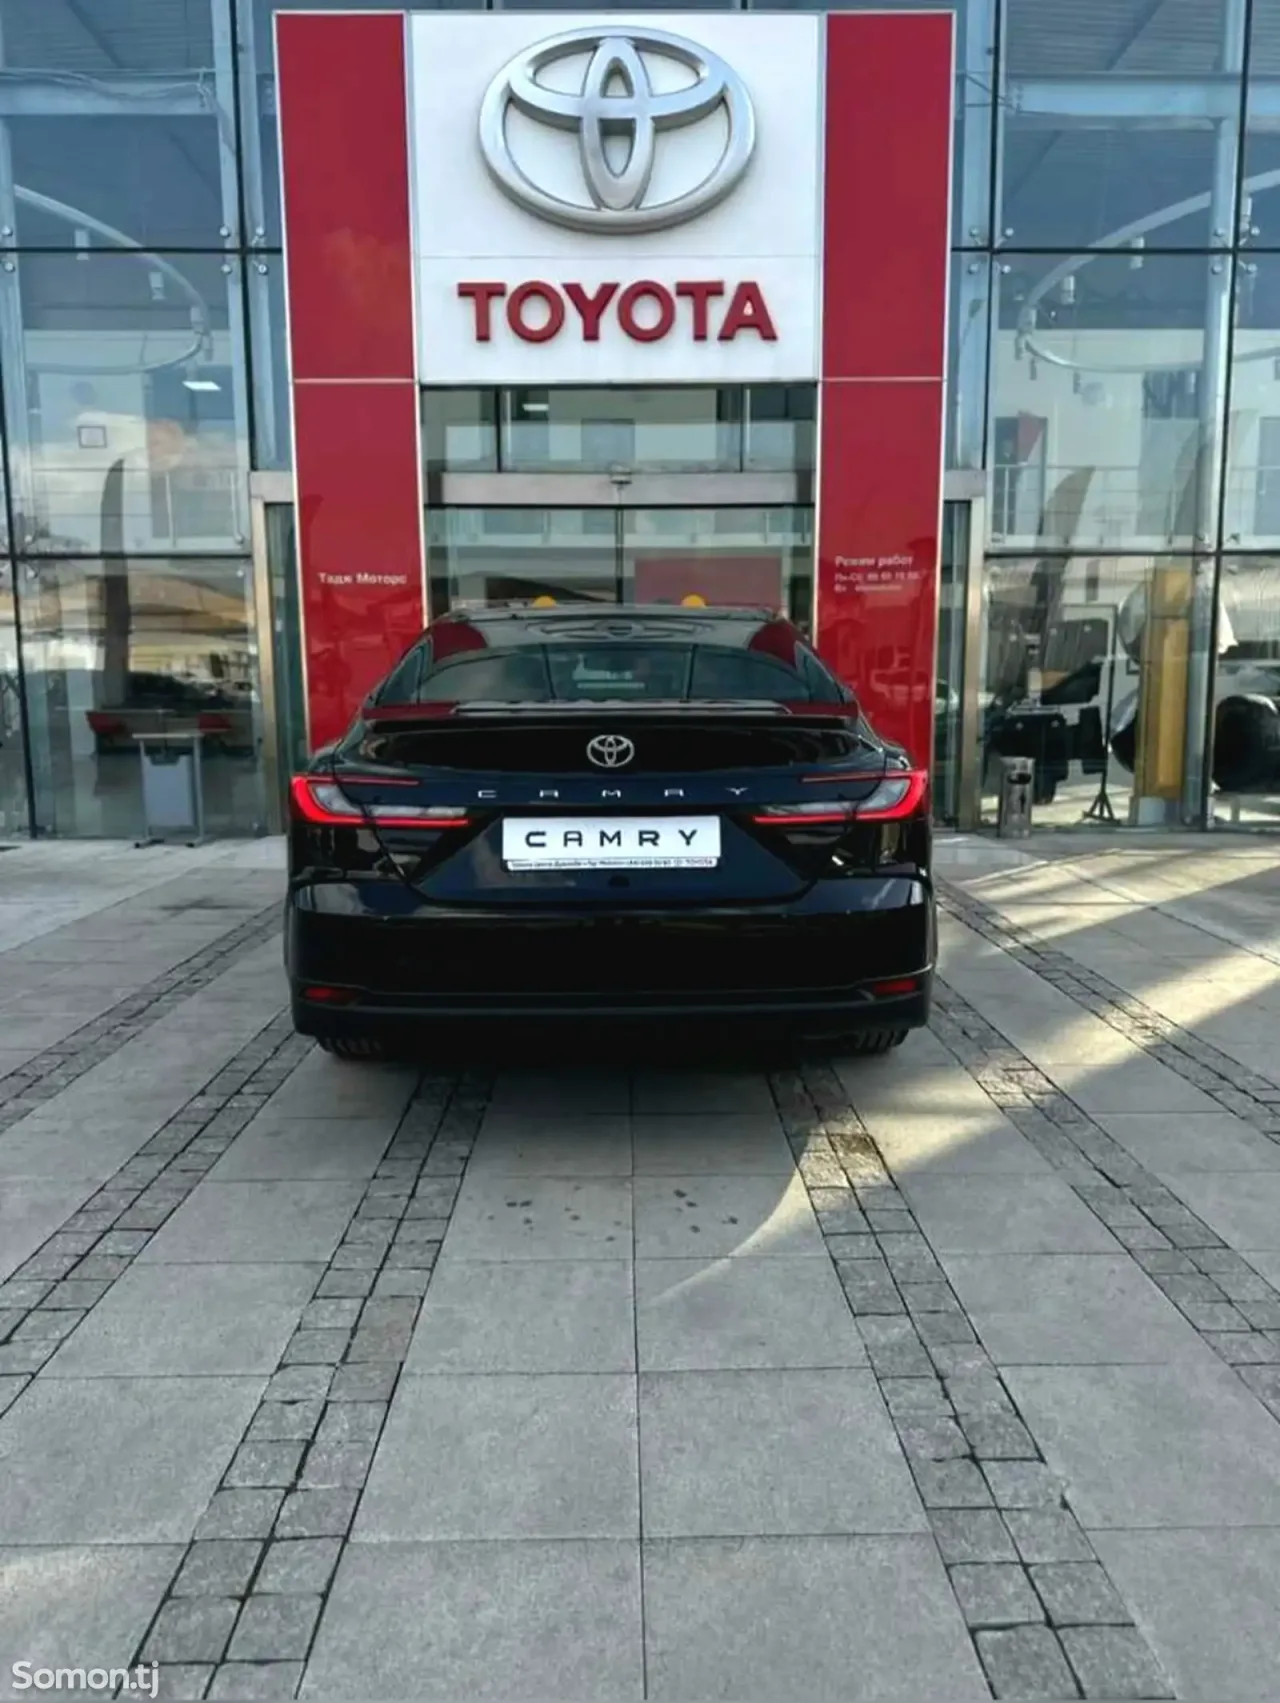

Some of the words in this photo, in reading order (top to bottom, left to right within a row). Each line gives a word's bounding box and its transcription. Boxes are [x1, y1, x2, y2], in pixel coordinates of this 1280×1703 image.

[458, 281, 778, 344] TOYOTA
[356, 572, 408, 586] Моторс
[477, 787, 749, 799] CAMRY
[525, 829, 698, 848] CAMRY
